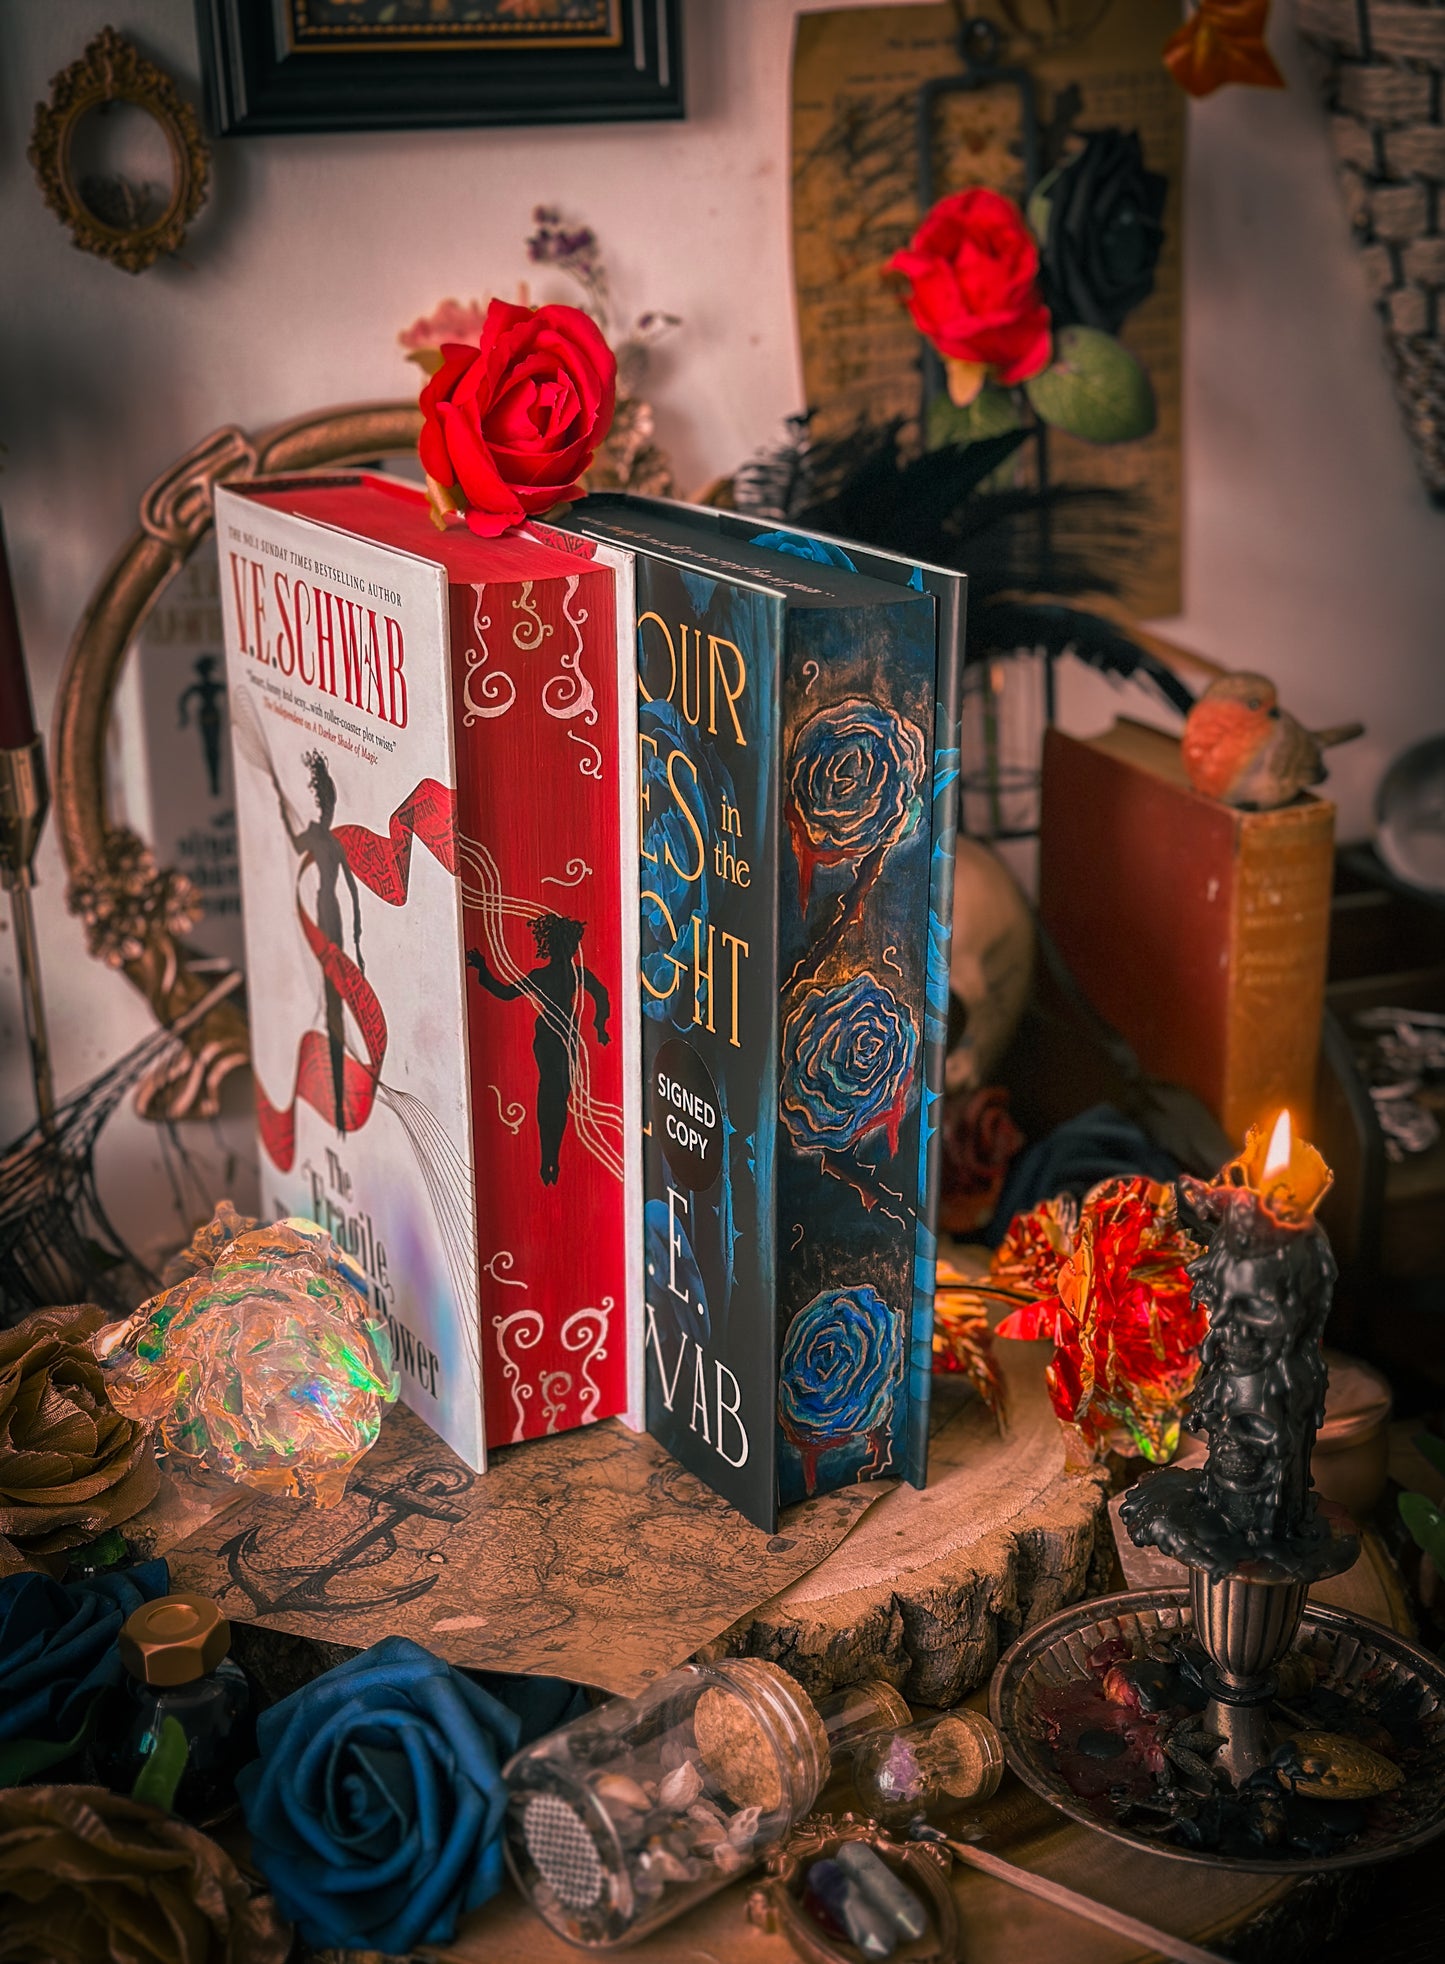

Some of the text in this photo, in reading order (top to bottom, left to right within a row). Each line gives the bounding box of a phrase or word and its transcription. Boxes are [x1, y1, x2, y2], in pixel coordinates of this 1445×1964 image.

[260, 540, 288, 561] SUNDAY
[290, 551, 312, 571] TIMES
[314, 561, 365, 592] BESTSELLING
[368, 582, 402, 607] AUTHOR
[318, 723, 337, 744] Darker
[337, 733, 354, 752] Shade
[354, 744, 361, 759] of
[361, 745, 378, 766] Magic
[324, 708, 361, 737] roller-coaster
[362, 726, 375, 743] plot
[720, 795, 743, 838] in
[713, 840, 751, 889] the
[657, 1071, 717, 1130] SIGNED
[666, 1113, 709, 1160] COPY
[325, 1146, 352, 1204] The
